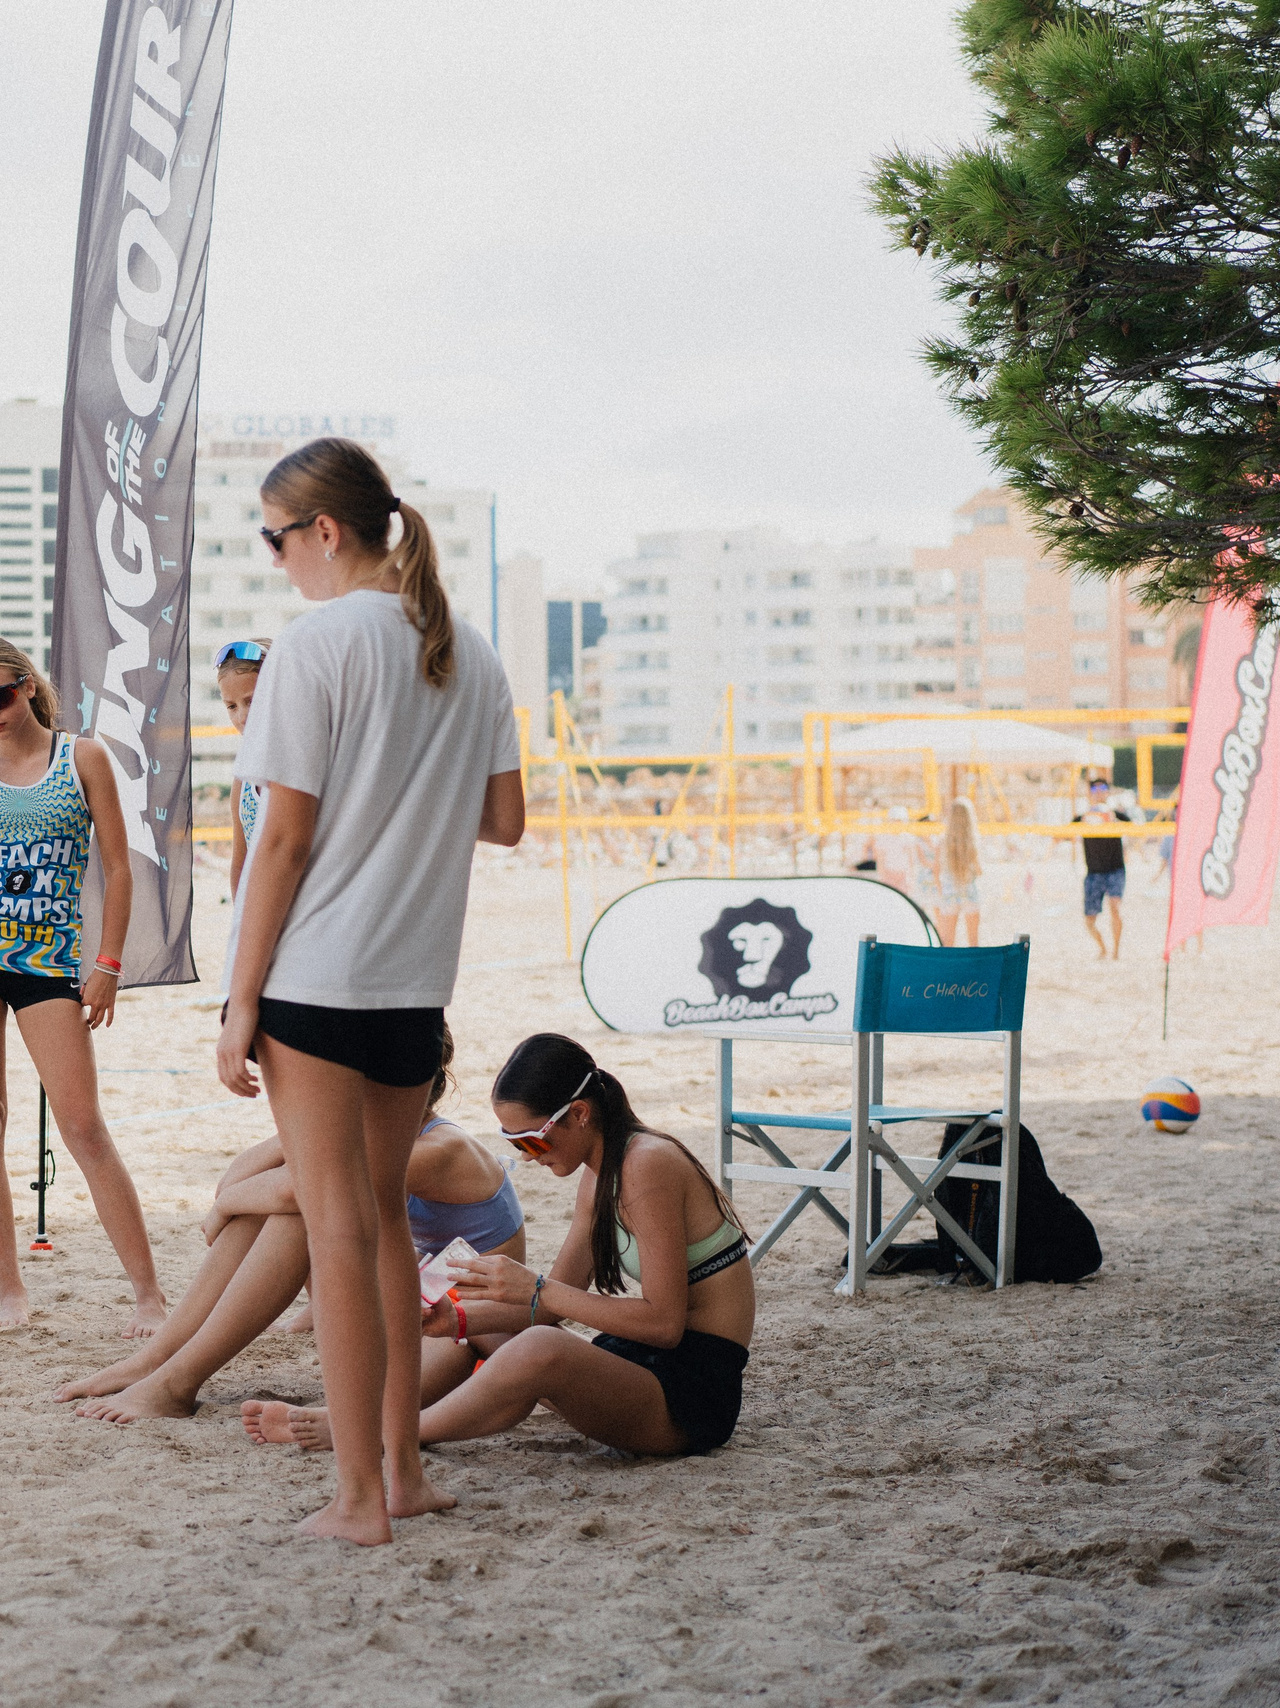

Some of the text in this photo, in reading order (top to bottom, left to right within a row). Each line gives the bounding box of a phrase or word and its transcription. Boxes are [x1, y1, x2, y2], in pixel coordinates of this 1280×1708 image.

[111, 0, 181, 417] COUR
[105, 420, 121, 483] OF
[232, 415, 396, 437] GLOBALES
[125, 422, 147, 505] THE
[902, 985, 914, 998] IL
